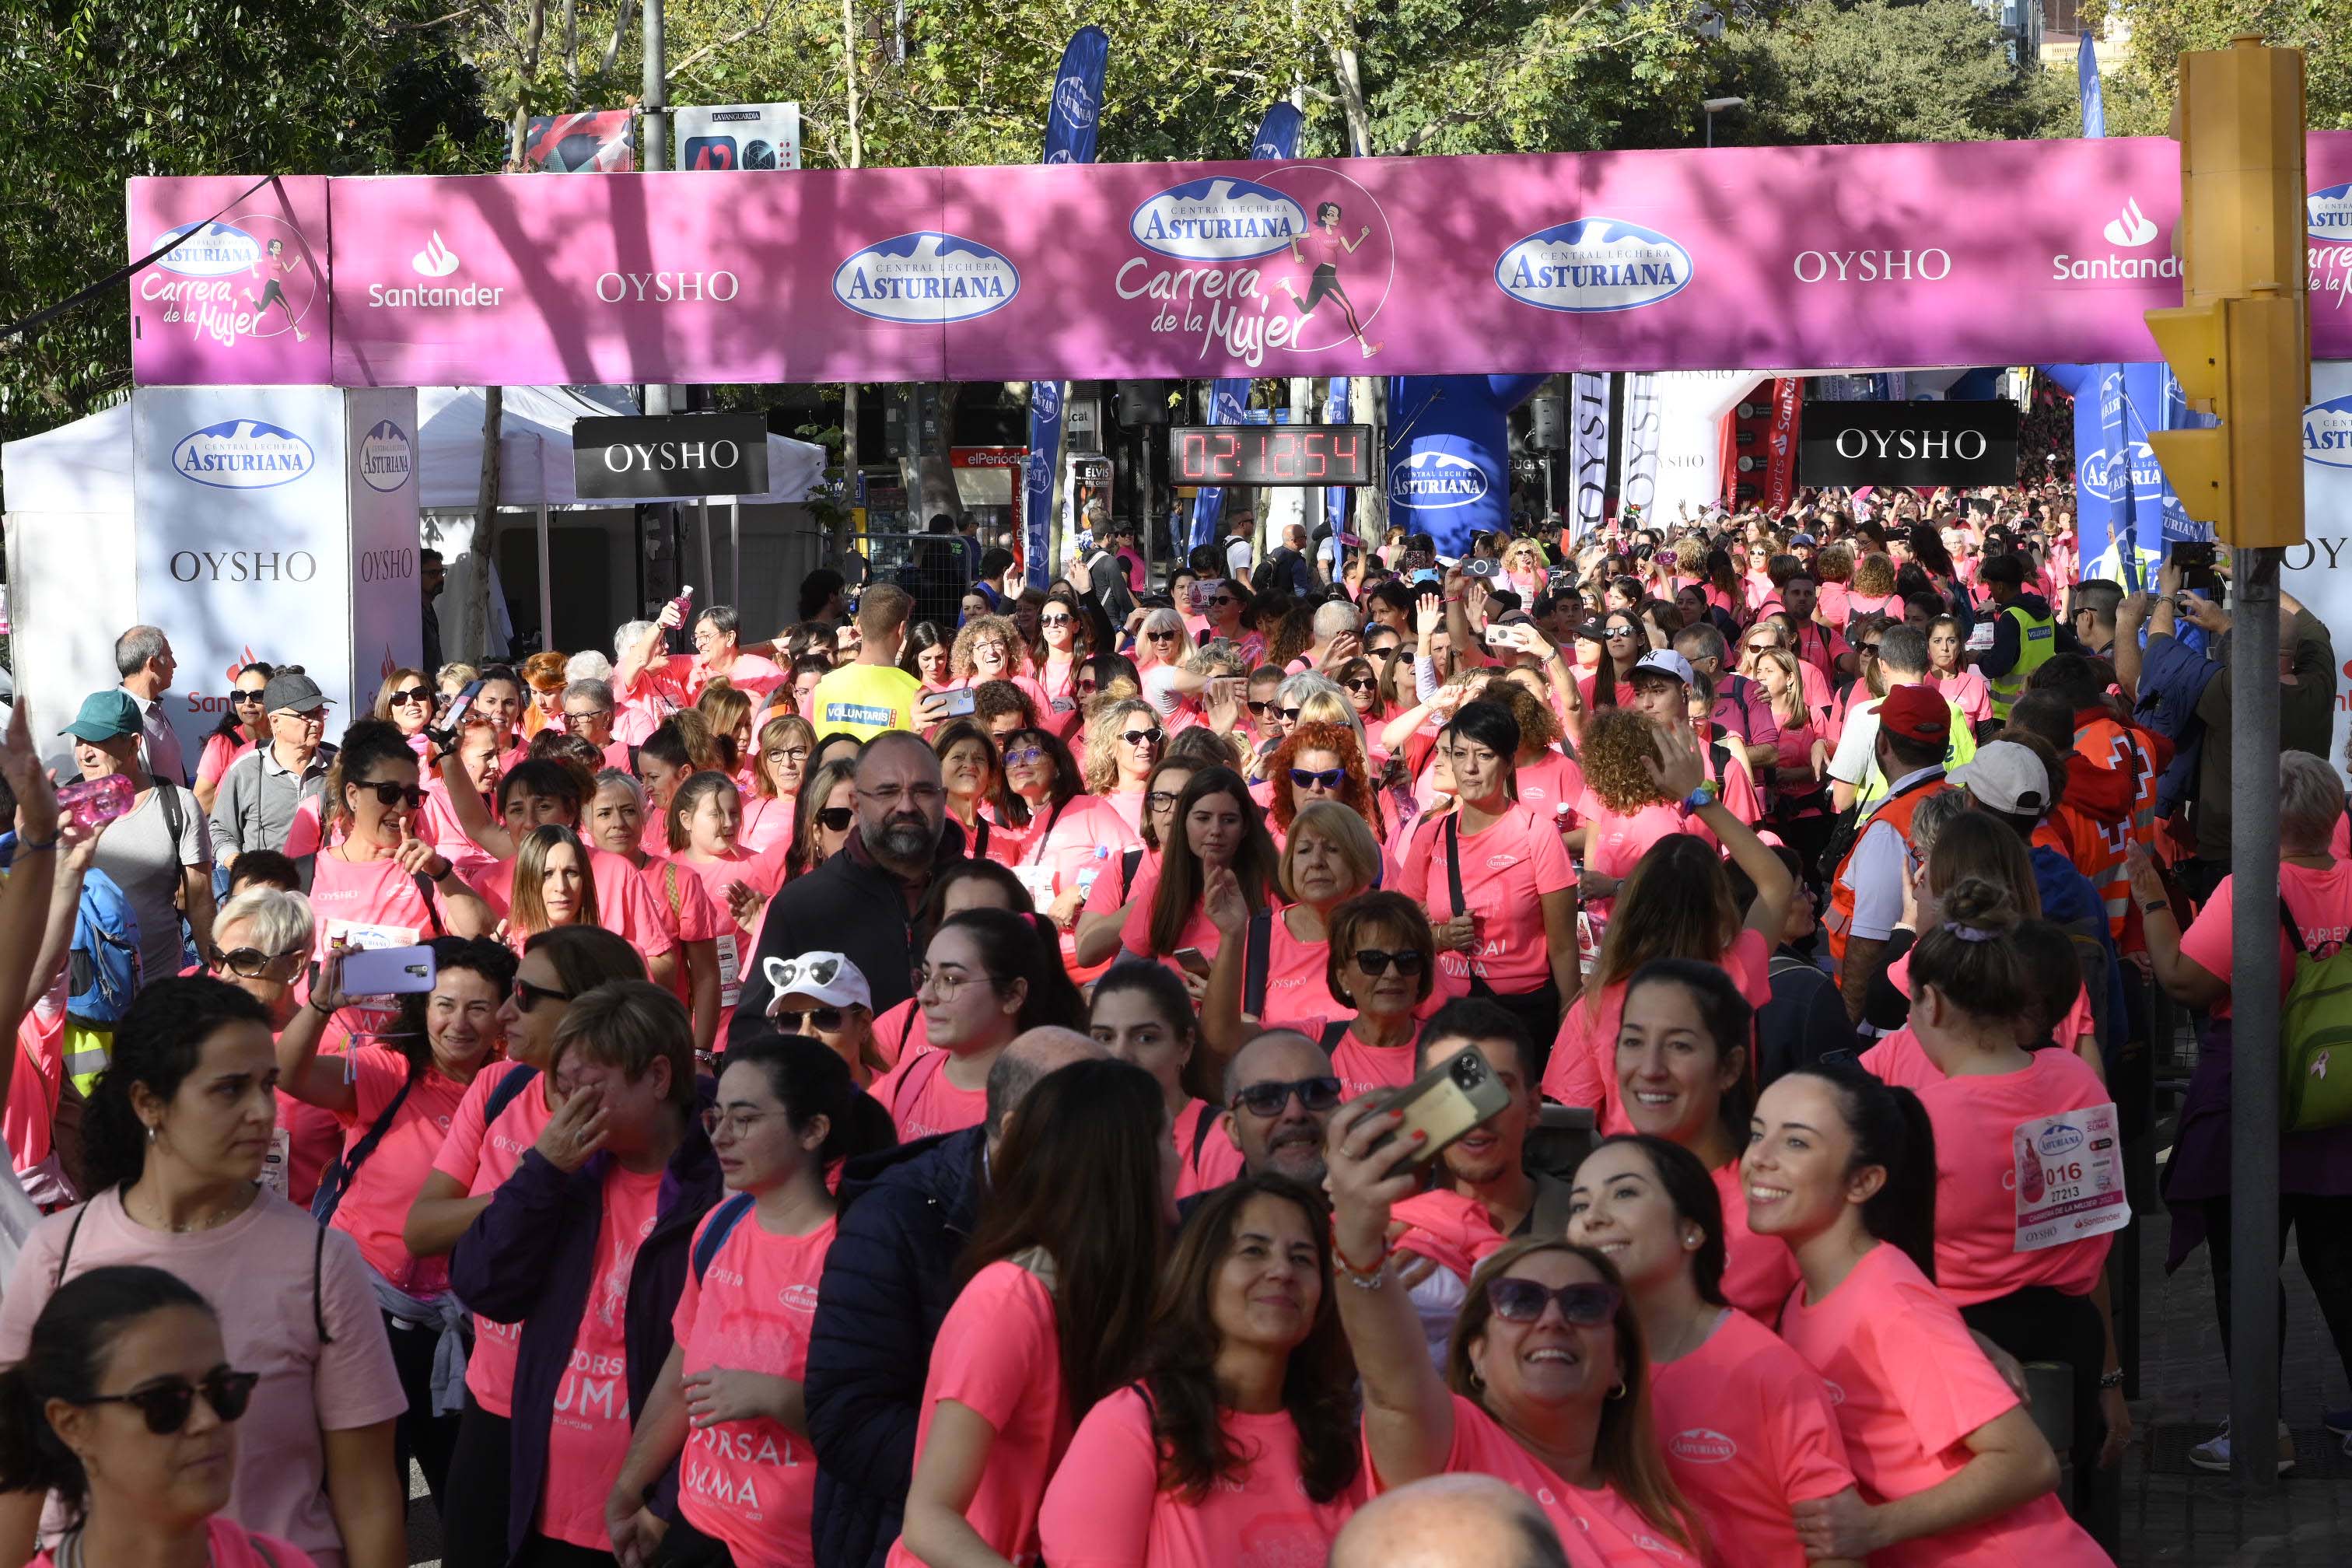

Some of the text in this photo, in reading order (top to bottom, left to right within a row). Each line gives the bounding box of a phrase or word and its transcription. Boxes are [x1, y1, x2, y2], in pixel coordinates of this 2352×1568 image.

[1171, 205, 1289, 215] CENTRAL LECHERA
[1143, 209, 1292, 242] ASTURIANA
[876, 263, 999, 272] CENTRAL LECHERA
[1541, 250, 1671, 260] CENTRAL LECHERA
[1794, 247, 1951, 283] OYSHO
[847, 266, 1006, 300] ASTURIANA
[1115, 257, 1260, 300] Carrera
[1510, 254, 1677, 289] ASTURIANA
[2325, 269, 2340, 291] la
[142, 272, 232, 302] Carrera
[369, 283, 504, 307] Santander
[596, 271, 739, 303] OYSHO
[163, 299, 267, 347] de la Mujer
[1150, 295, 1314, 368] de la Mujer
[1777, 377, 1796, 432] Santa
[183, 445, 304, 472] ASTURIANA
[604, 439, 739, 473] OYSHO
[1183, 435, 1356, 477] 02:12:54
[1836, 428, 1986, 460] OYSHO
[363, 447, 408, 474] ASTURIANA
[1085, 467, 1109, 478] ELVIS
[1392, 474, 1481, 496] ASTURIANA
[170, 551, 317, 583] OYSHO
[369, 548, 413, 583] OYSHO
[187, 691, 234, 713] San
[828, 708, 888, 722] VOLUNTARIS
[2087, 1122, 2110, 1132] SUMA
[2041, 1136, 2079, 1151] ASTURIANA
[2046, 1162, 2082, 1185] 016
[2051, 1186, 2080, 1203] 27213
[2025, 1213, 2121, 1243] OYSHO Santander
[2028, 1209, 2055, 1223] CARRERA
[2055, 1207, 2063, 1216] DE
[687, 1461, 759, 1509] SUMA
